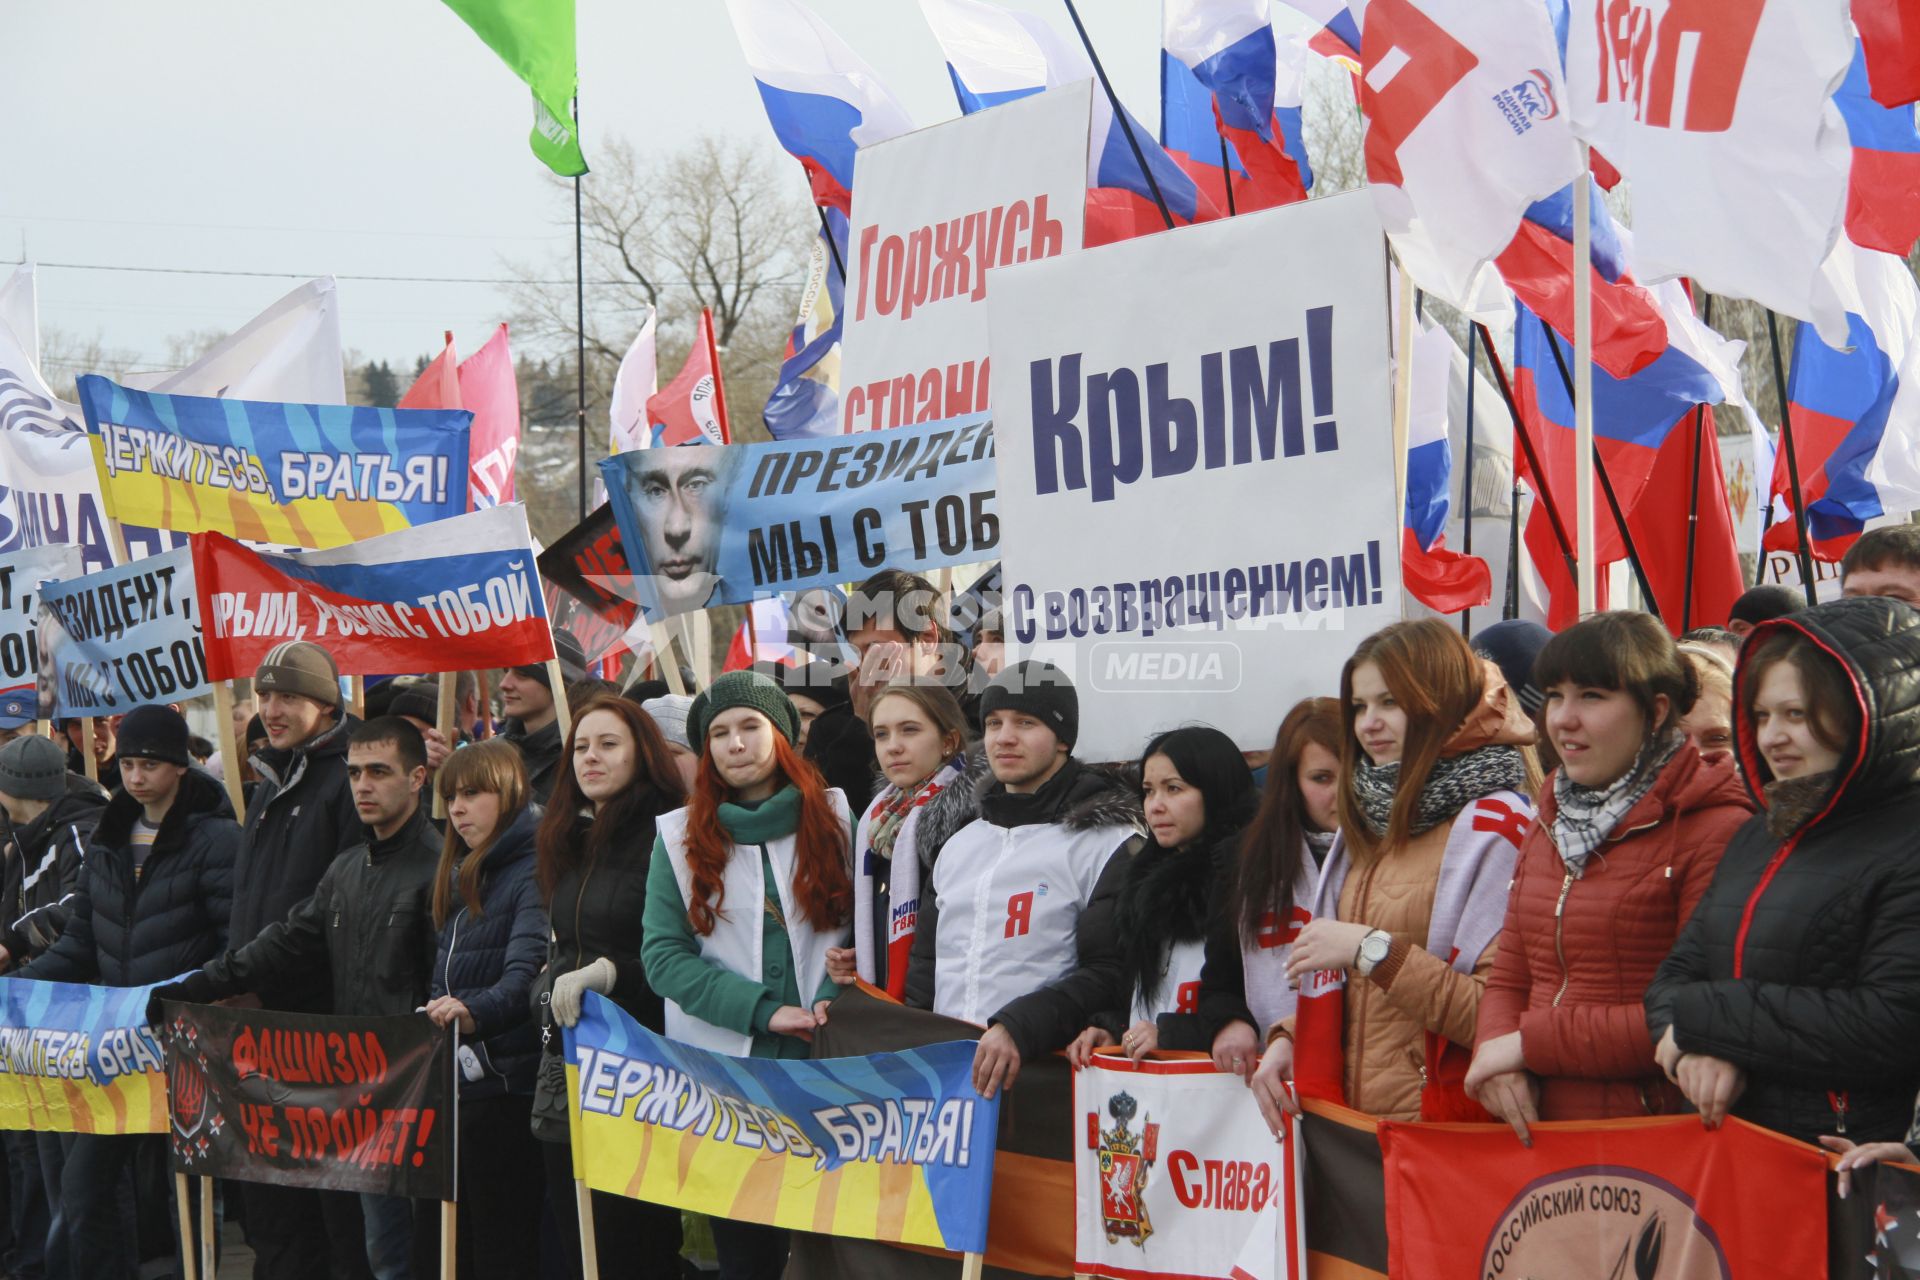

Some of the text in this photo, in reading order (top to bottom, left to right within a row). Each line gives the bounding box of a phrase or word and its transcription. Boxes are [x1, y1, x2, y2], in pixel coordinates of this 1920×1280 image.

[1491, 94, 1524, 136] РОССИЯ
[1500, 88, 1532, 130] ЕДИНАЯ
[855, 194, 1063, 322] Горжусь
[1030, 305, 1339, 503] Крым!
[280, 451, 449, 504] БРАТЬЯ!
[747, 489, 1001, 587] МЫ С ТОБ
[417, 559, 535, 638] ТОБОЙ
[1044, 540, 1384, 640] возвращением!
[1004, 891, 1034, 939] Я
[232, 1024, 388, 1084] ФАШИЗМ
[239, 1092, 436, 1171] НЕ ПРОЙДЕТ!
[811, 1097, 975, 1168] БРАТЬЯ!
[1166, 1149, 1271, 1213] Слава
[1590, 1185, 1641, 1216] СОЮЗ
